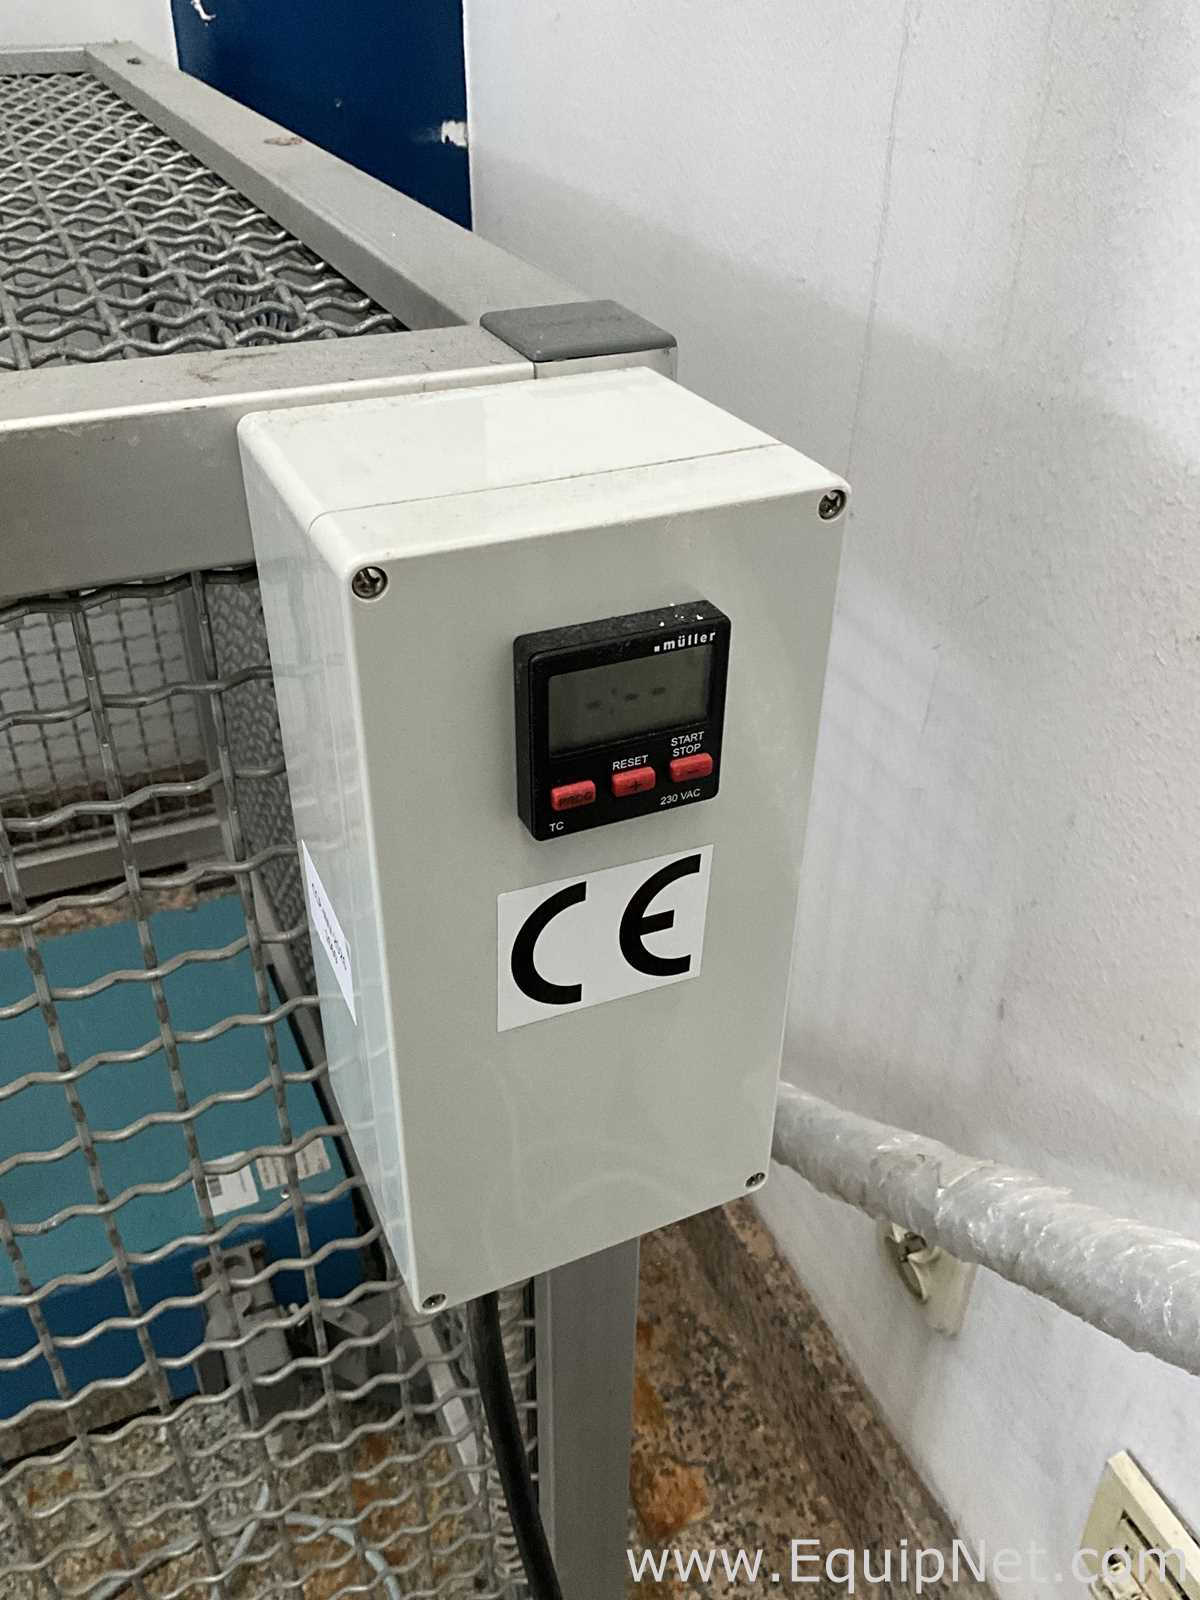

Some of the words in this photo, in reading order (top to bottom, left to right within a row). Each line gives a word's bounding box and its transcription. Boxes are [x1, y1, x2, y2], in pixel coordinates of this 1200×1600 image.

[671, 731, 704, 747] START
[672, 743, 701, 757] STOP
[612, 755, 649, 770] RESET
[660, 793, 678, 806] 230
[681, 788, 701, 801] VAC
[549, 821, 565, 832] TC
[511, 853, 702, 1005] CE
